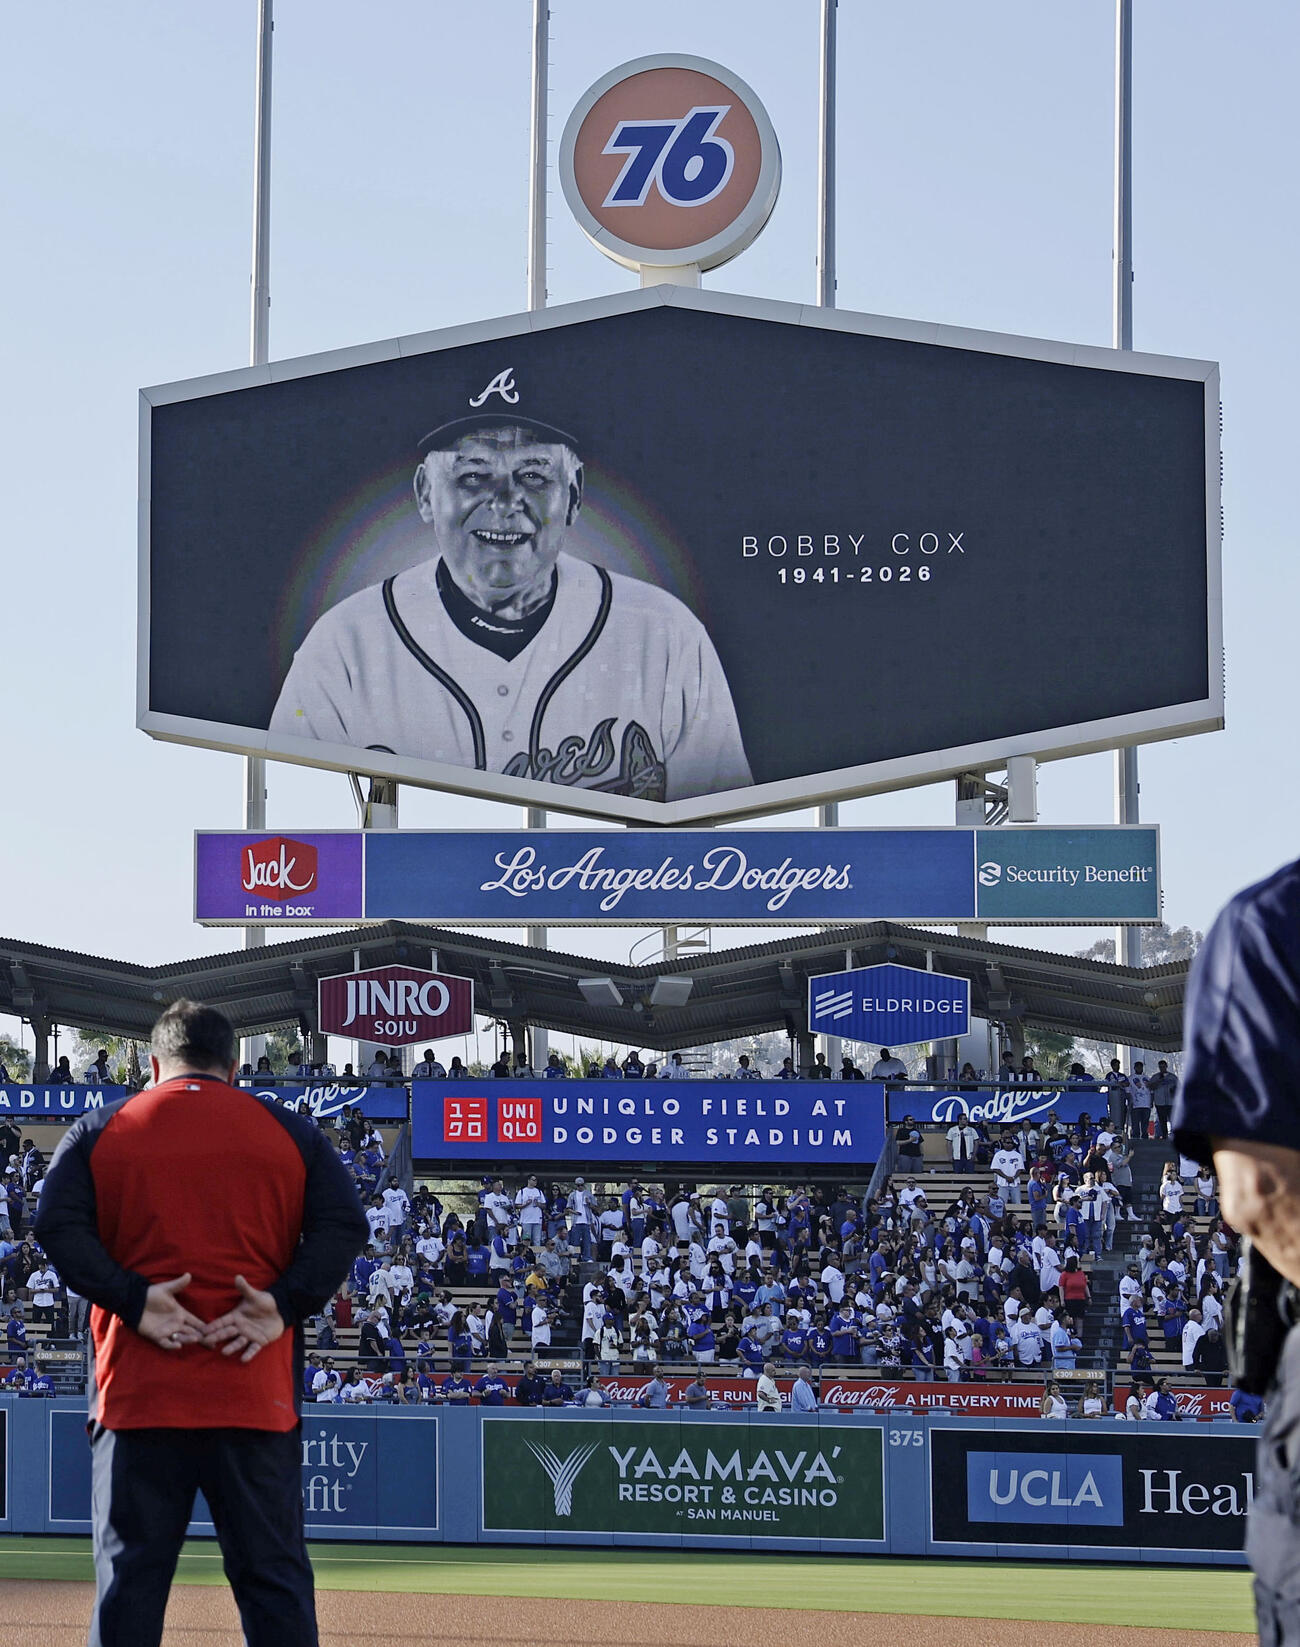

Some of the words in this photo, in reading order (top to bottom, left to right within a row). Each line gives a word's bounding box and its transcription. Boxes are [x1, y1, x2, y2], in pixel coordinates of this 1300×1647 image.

[601, 105, 735, 207] 76
[469, 367, 520, 407] A
[742, 534, 865, 557] BOBBY
[891, 532, 965, 555] COX
[777, 566, 931, 584] 1941-2026
[242, 844, 315, 891] Jack
[1006, 865, 1080, 886] Security
[1084, 865, 1149, 882] Benefit
[480, 846, 547, 897] Los
[547, 846, 695, 911] Angeles
[694, 846, 851, 911] Dodgers
[245, 904, 257, 916] in
[260, 904, 283, 916] the
[285, 904, 312, 916] box
[342, 979, 450, 1027] JINRO
[862, 998, 964, 1014] ELDRIDGE
[374, 1020, 417, 1038] SOJU
[0, 1090, 104, 1109] ADIUM
[553, 1098, 681, 1115] UNIQLO
[702, 1099, 790, 1116] FIELD
[812, 1100, 847, 1116] AT
[449, 1103, 482, 1118] ユニ
[503, 1103, 534, 1119] UNI
[448, 1121, 482, 1137] クロ
[503, 1121, 537, 1139] QLO
[553, 1127, 685, 1144] DODGER
[706, 1128, 853, 1146] STADIUM
[816, 1336, 825, 1348] LA
[723, 1391, 752, 1402] RUN
[824, 1385, 900, 1407] Coca-Cola
[905, 1394, 917, 1406] A
[920, 1394, 946, 1407] HIT
[949, 1395, 1000, 1408] EVERY
[1003, 1396, 1041, 1409] TIME
[888, 1430, 924, 1447] 375
[301, 1475, 347, 1512] fit
[618, 1483, 713, 1503] RESORT
[721, 1486, 736, 1504] &
[744, 1487, 838, 1507] CASINO
[988, 1469, 1104, 1508] UCLA
[687, 1508, 716, 1520] SAN
[721, 1510, 780, 1522] MANUEL
